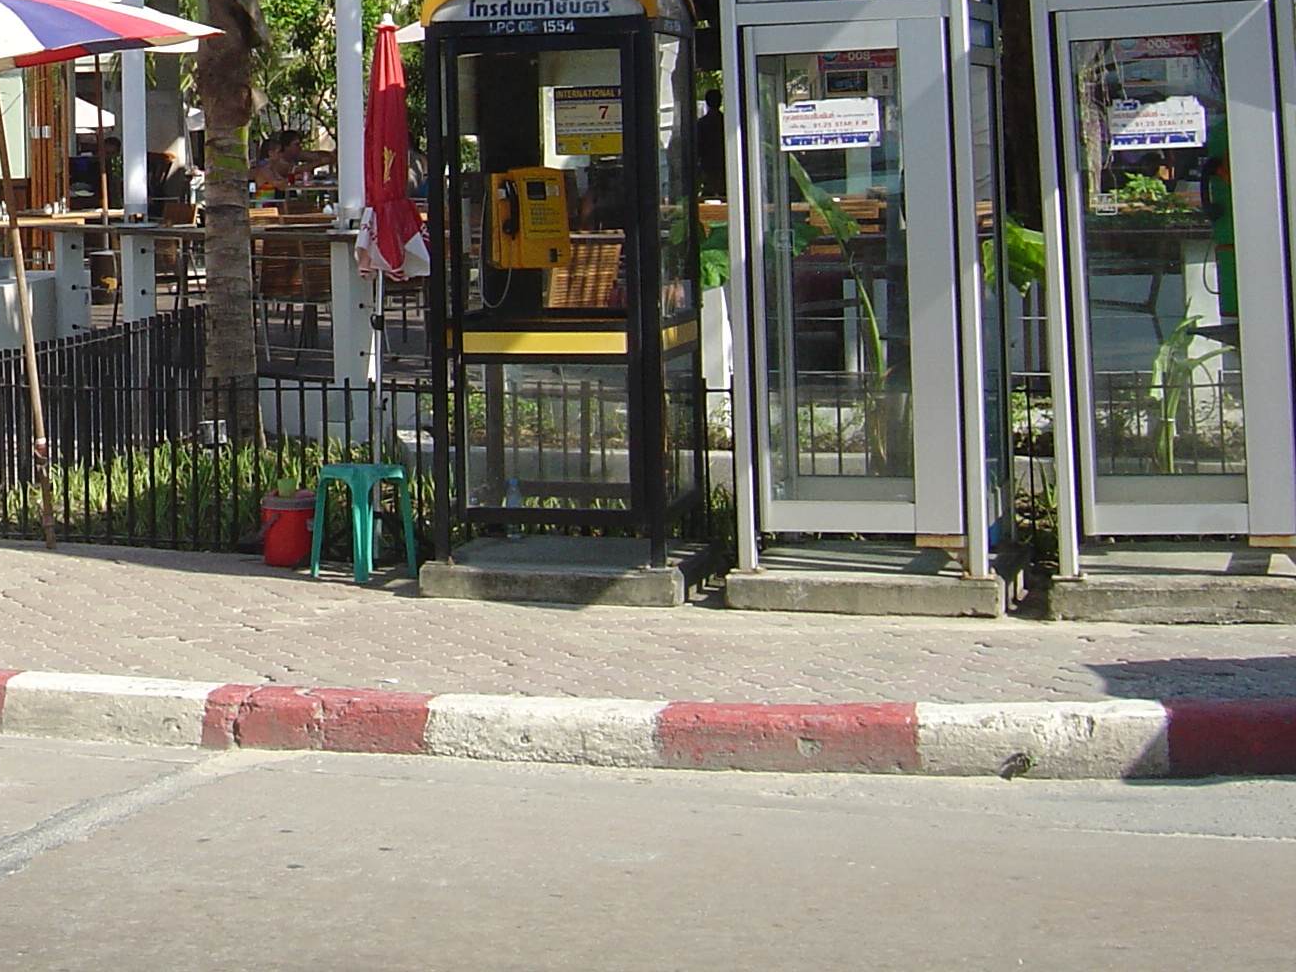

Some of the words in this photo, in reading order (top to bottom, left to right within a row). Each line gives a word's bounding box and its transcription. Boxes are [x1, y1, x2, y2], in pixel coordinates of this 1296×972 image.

[542, 19, 575, 33] 1554
[555, 88, 615, 99] INTERNATIONAL
[598, 105, 609, 120] 7
